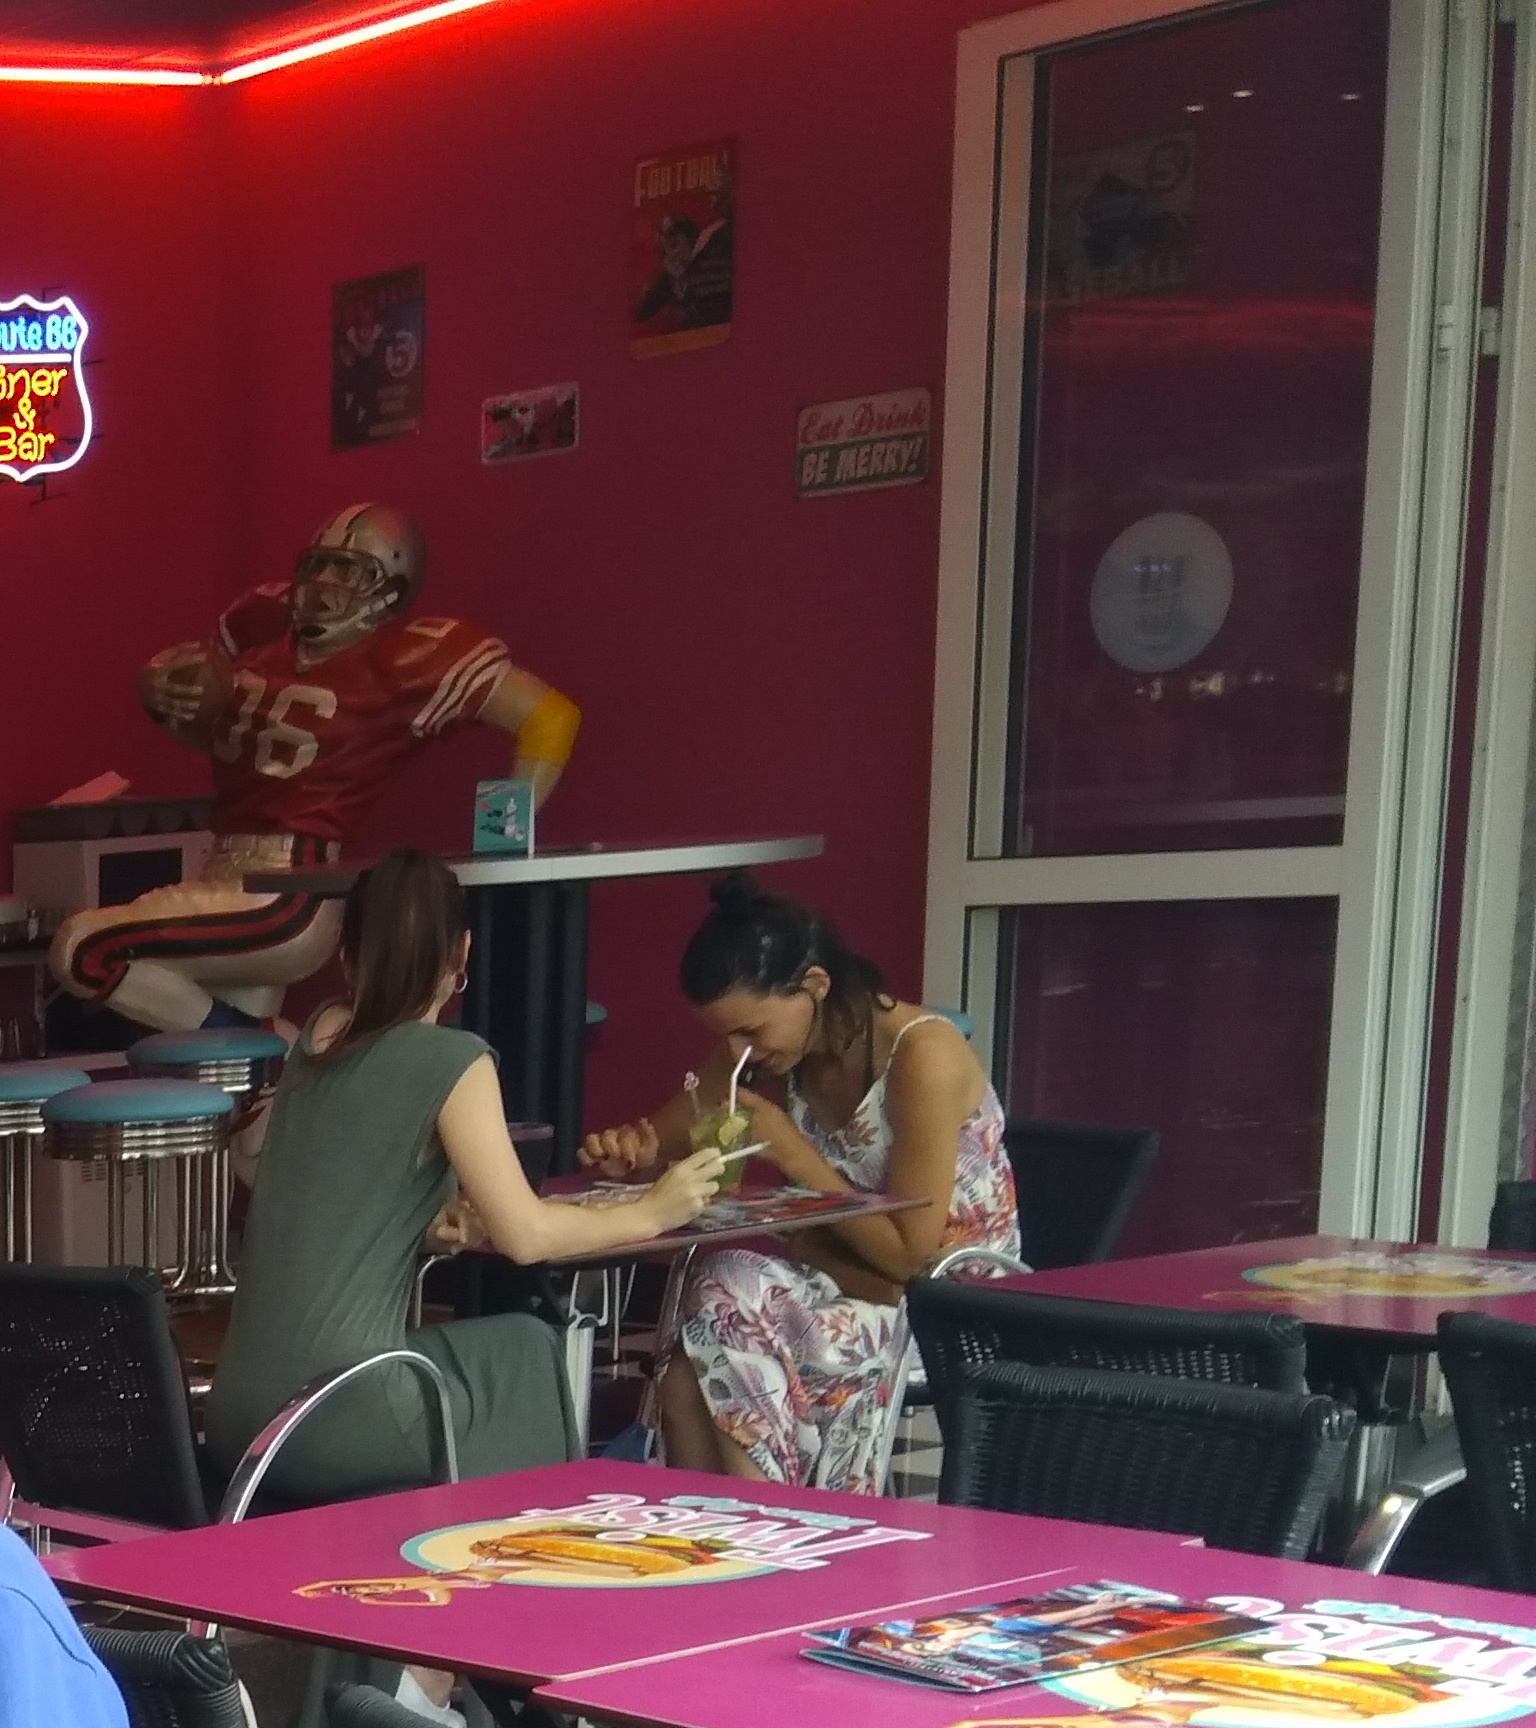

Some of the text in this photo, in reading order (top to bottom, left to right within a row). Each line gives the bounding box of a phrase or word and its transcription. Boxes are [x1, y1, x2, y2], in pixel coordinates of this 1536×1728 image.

[45, 313, 77, 351] 66
[13, 397, 37, 431] &
[800, 411, 844, 446] Eat
[800, 437, 924, 487] BE MERRY!
